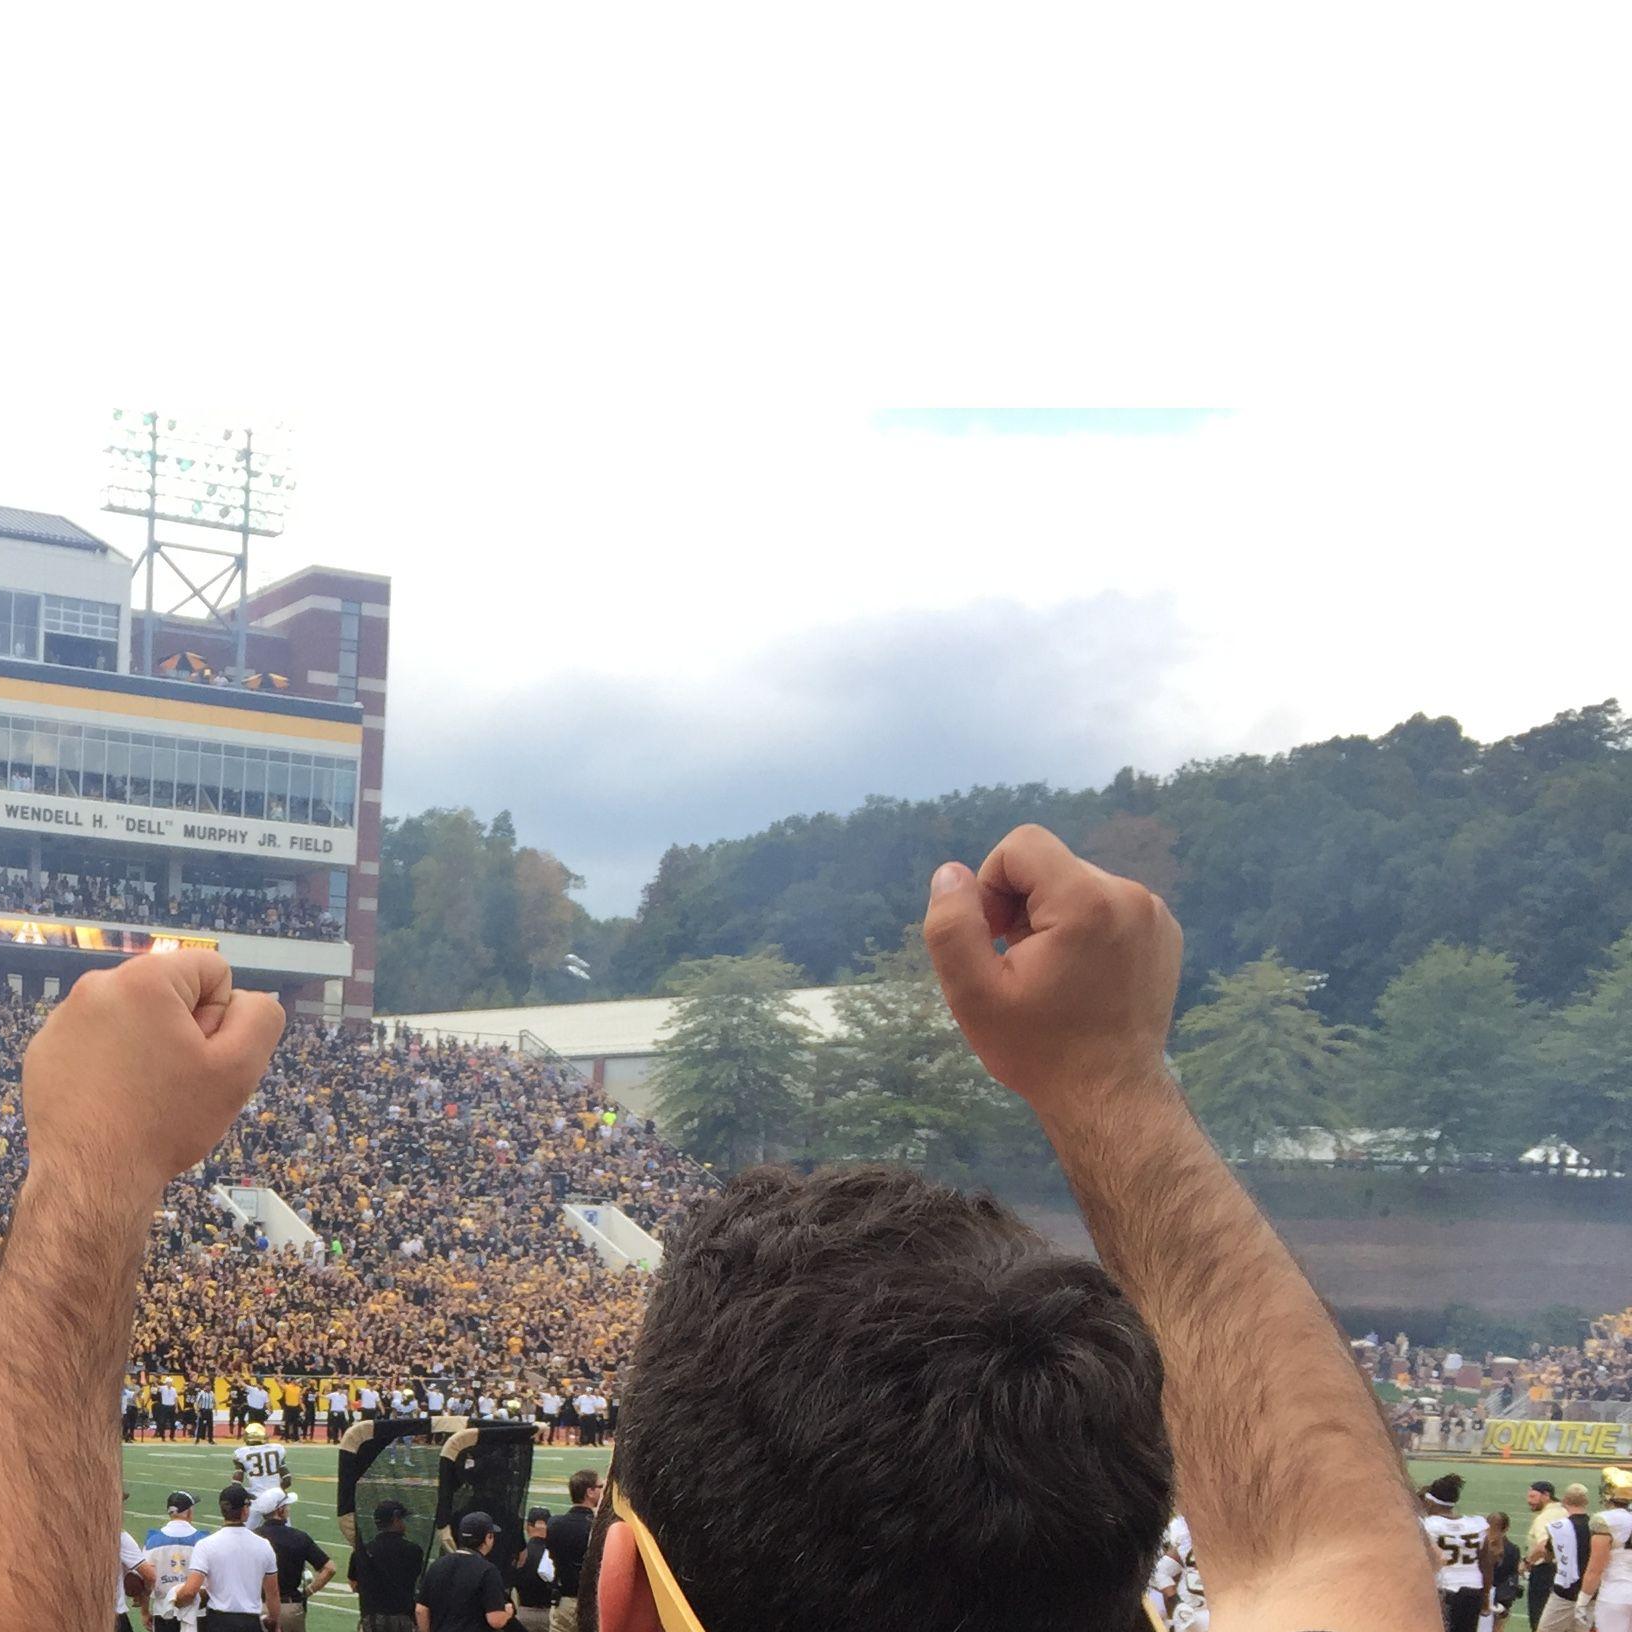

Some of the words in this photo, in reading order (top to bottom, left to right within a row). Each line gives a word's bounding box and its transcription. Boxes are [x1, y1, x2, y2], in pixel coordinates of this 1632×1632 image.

[5, 803, 83, 826] WENDELL
[92, 813, 108, 829] H.
[116, 813, 173, 836] "DELL"
[183, 823, 248, 845] MURPHY
[257, 833, 281, 849] JR.
[289, 836, 333, 854] FIELD
[1483, 1420, 1550, 1451] JOIN
[1555, 1422, 1622, 1455] THE
[246, 1450, 280, 1477] 30
[1437, 1533, 1480, 1566] 55
